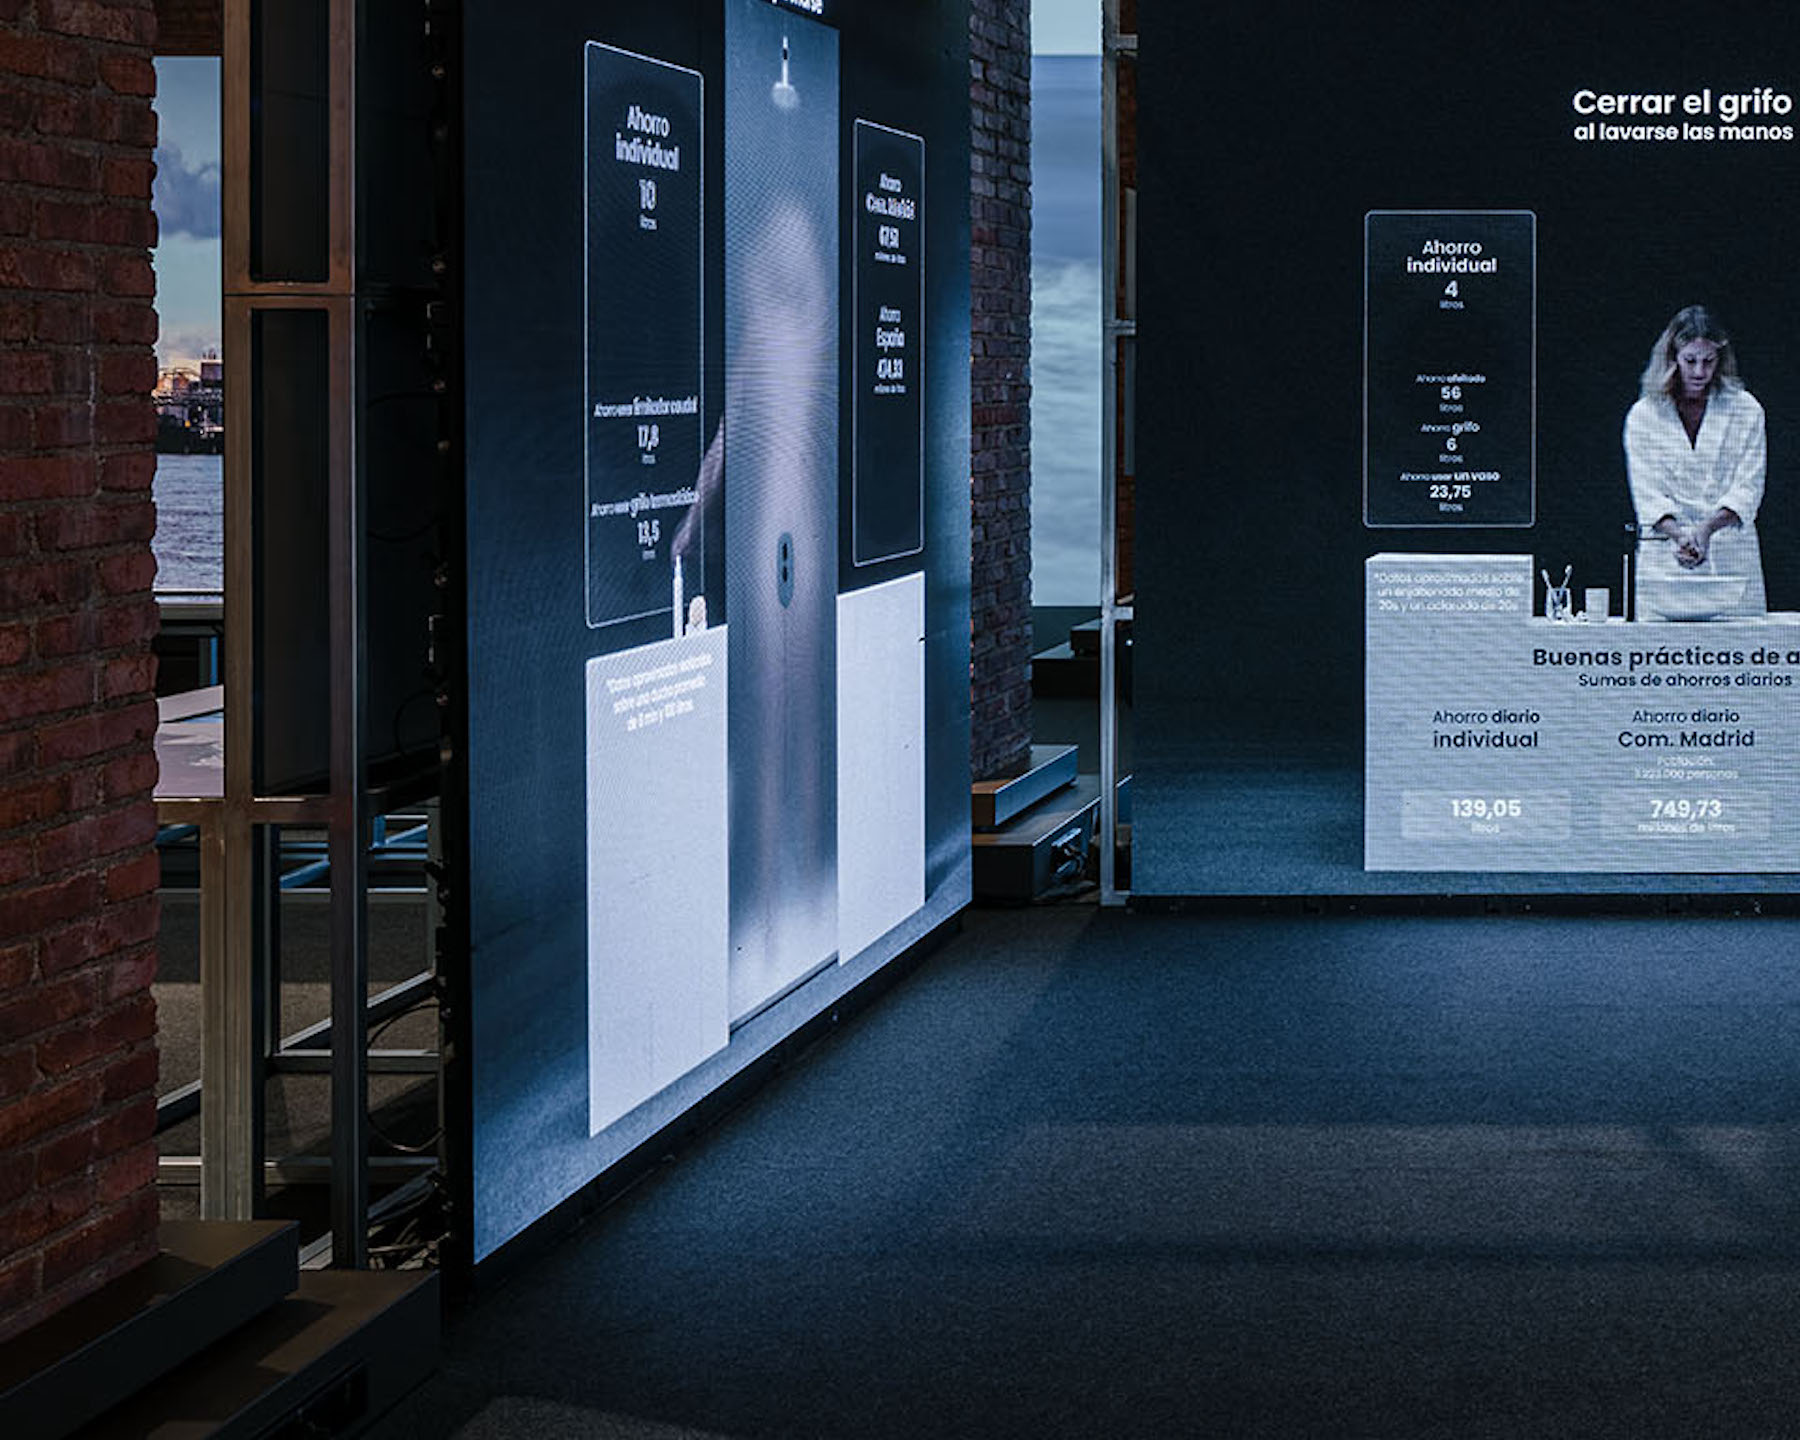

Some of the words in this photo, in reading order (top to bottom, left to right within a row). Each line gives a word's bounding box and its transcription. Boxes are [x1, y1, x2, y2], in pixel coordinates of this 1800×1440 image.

[1572, 89, 1676, 114] Cerrar
[1682, 88, 1711, 114] el
[1718, 87, 1792, 123] grifo
[627, 106, 670, 137] Ahorro
[1573, 122, 1595, 140] al
[1598, 122, 1679, 140] lavarse
[1682, 122, 1715, 140] las
[1718, 125, 1794, 140] manos
[616, 133, 680, 171] individual
[638, 179, 656, 210] 10
[1421, 239, 1483, 255] Ahorro
[1406, 257, 1497, 273] individual
[1444, 279, 1458, 297] 4
[876, 327, 905, 353] España
[1440, 385, 1462, 400] 56
[1451, 420, 1481, 436] grifo
[637, 424, 660, 451] 17,8
[1445, 436, 1458, 451] 6
[1453, 471, 1471, 481] un
[1470, 471, 1501, 481] vaso
[1429, 484, 1472, 500] 23,75
[637, 521, 660, 546] 13,5
[1532, 648, 1622, 666] Buenas
[1628, 645, 1744, 672] prácticas
[1749, 646, 1780, 665] de
[1578, 672, 1637, 686] Sumas
[1639, 672, 1662, 686] de
[1664, 672, 1731, 687] ahorros
[1734, 671, 1793, 686] diarios
[1432, 709, 1488, 724] Ahorro
[1490, 708, 1540, 724] diario
[1631, 709, 1688, 723] Ahorro
[1690, 708, 1740, 723] diario
[1433, 730, 1538, 748] individual
[1617, 730, 1674, 748] Com.
[1679, 729, 1755, 747] Madrid
[1451, 798, 1522, 820] 139,05
[1651, 798, 1722, 821] 749,73
